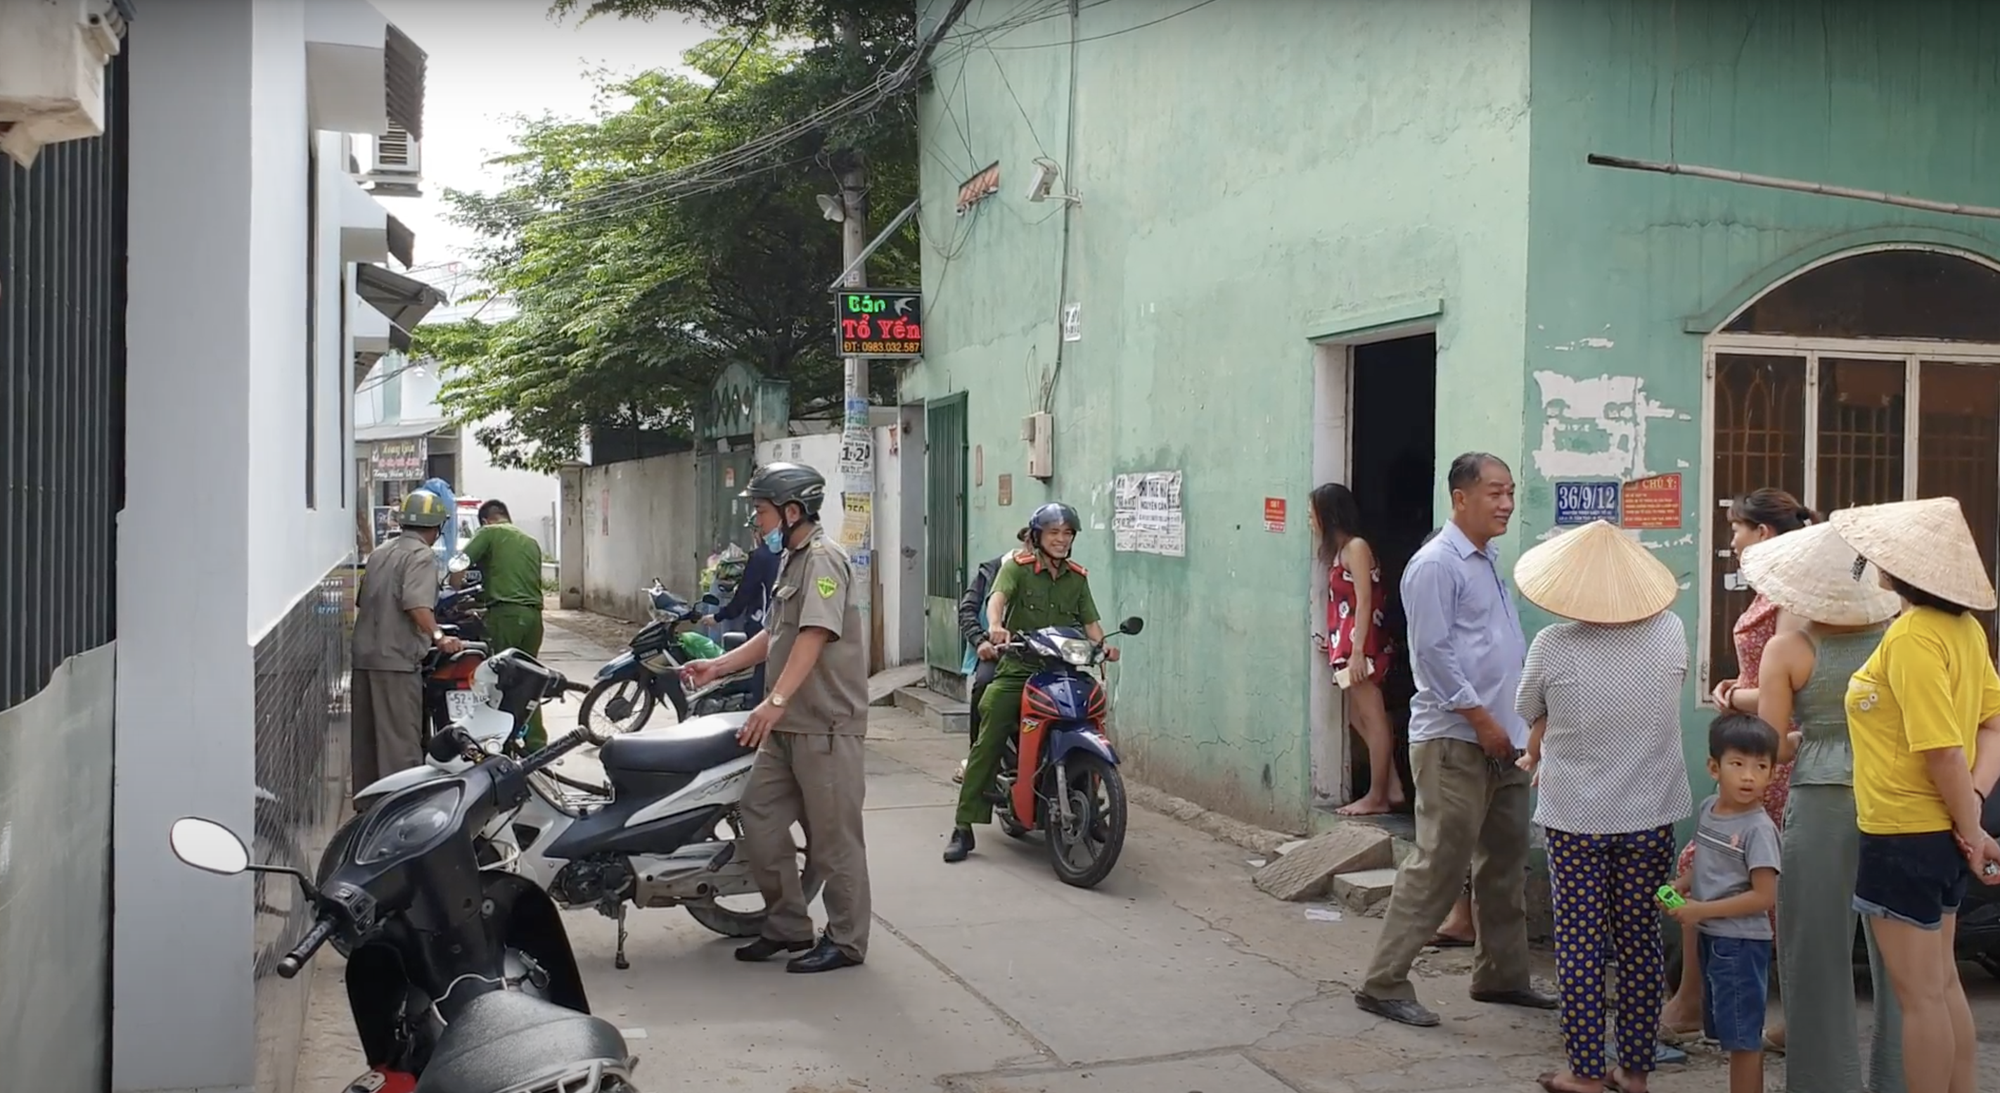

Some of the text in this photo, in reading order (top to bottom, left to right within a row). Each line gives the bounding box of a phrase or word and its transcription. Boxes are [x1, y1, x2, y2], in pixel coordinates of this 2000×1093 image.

[848, 295, 886, 313] Bán
[842, 314, 922, 339] Tổ Yến
[844, 341, 920, 352] ĐT: 0983.032.587
[1642, 476, 1664, 489] CHÚ
[1559, 486, 1615, 510] 36/9/12
